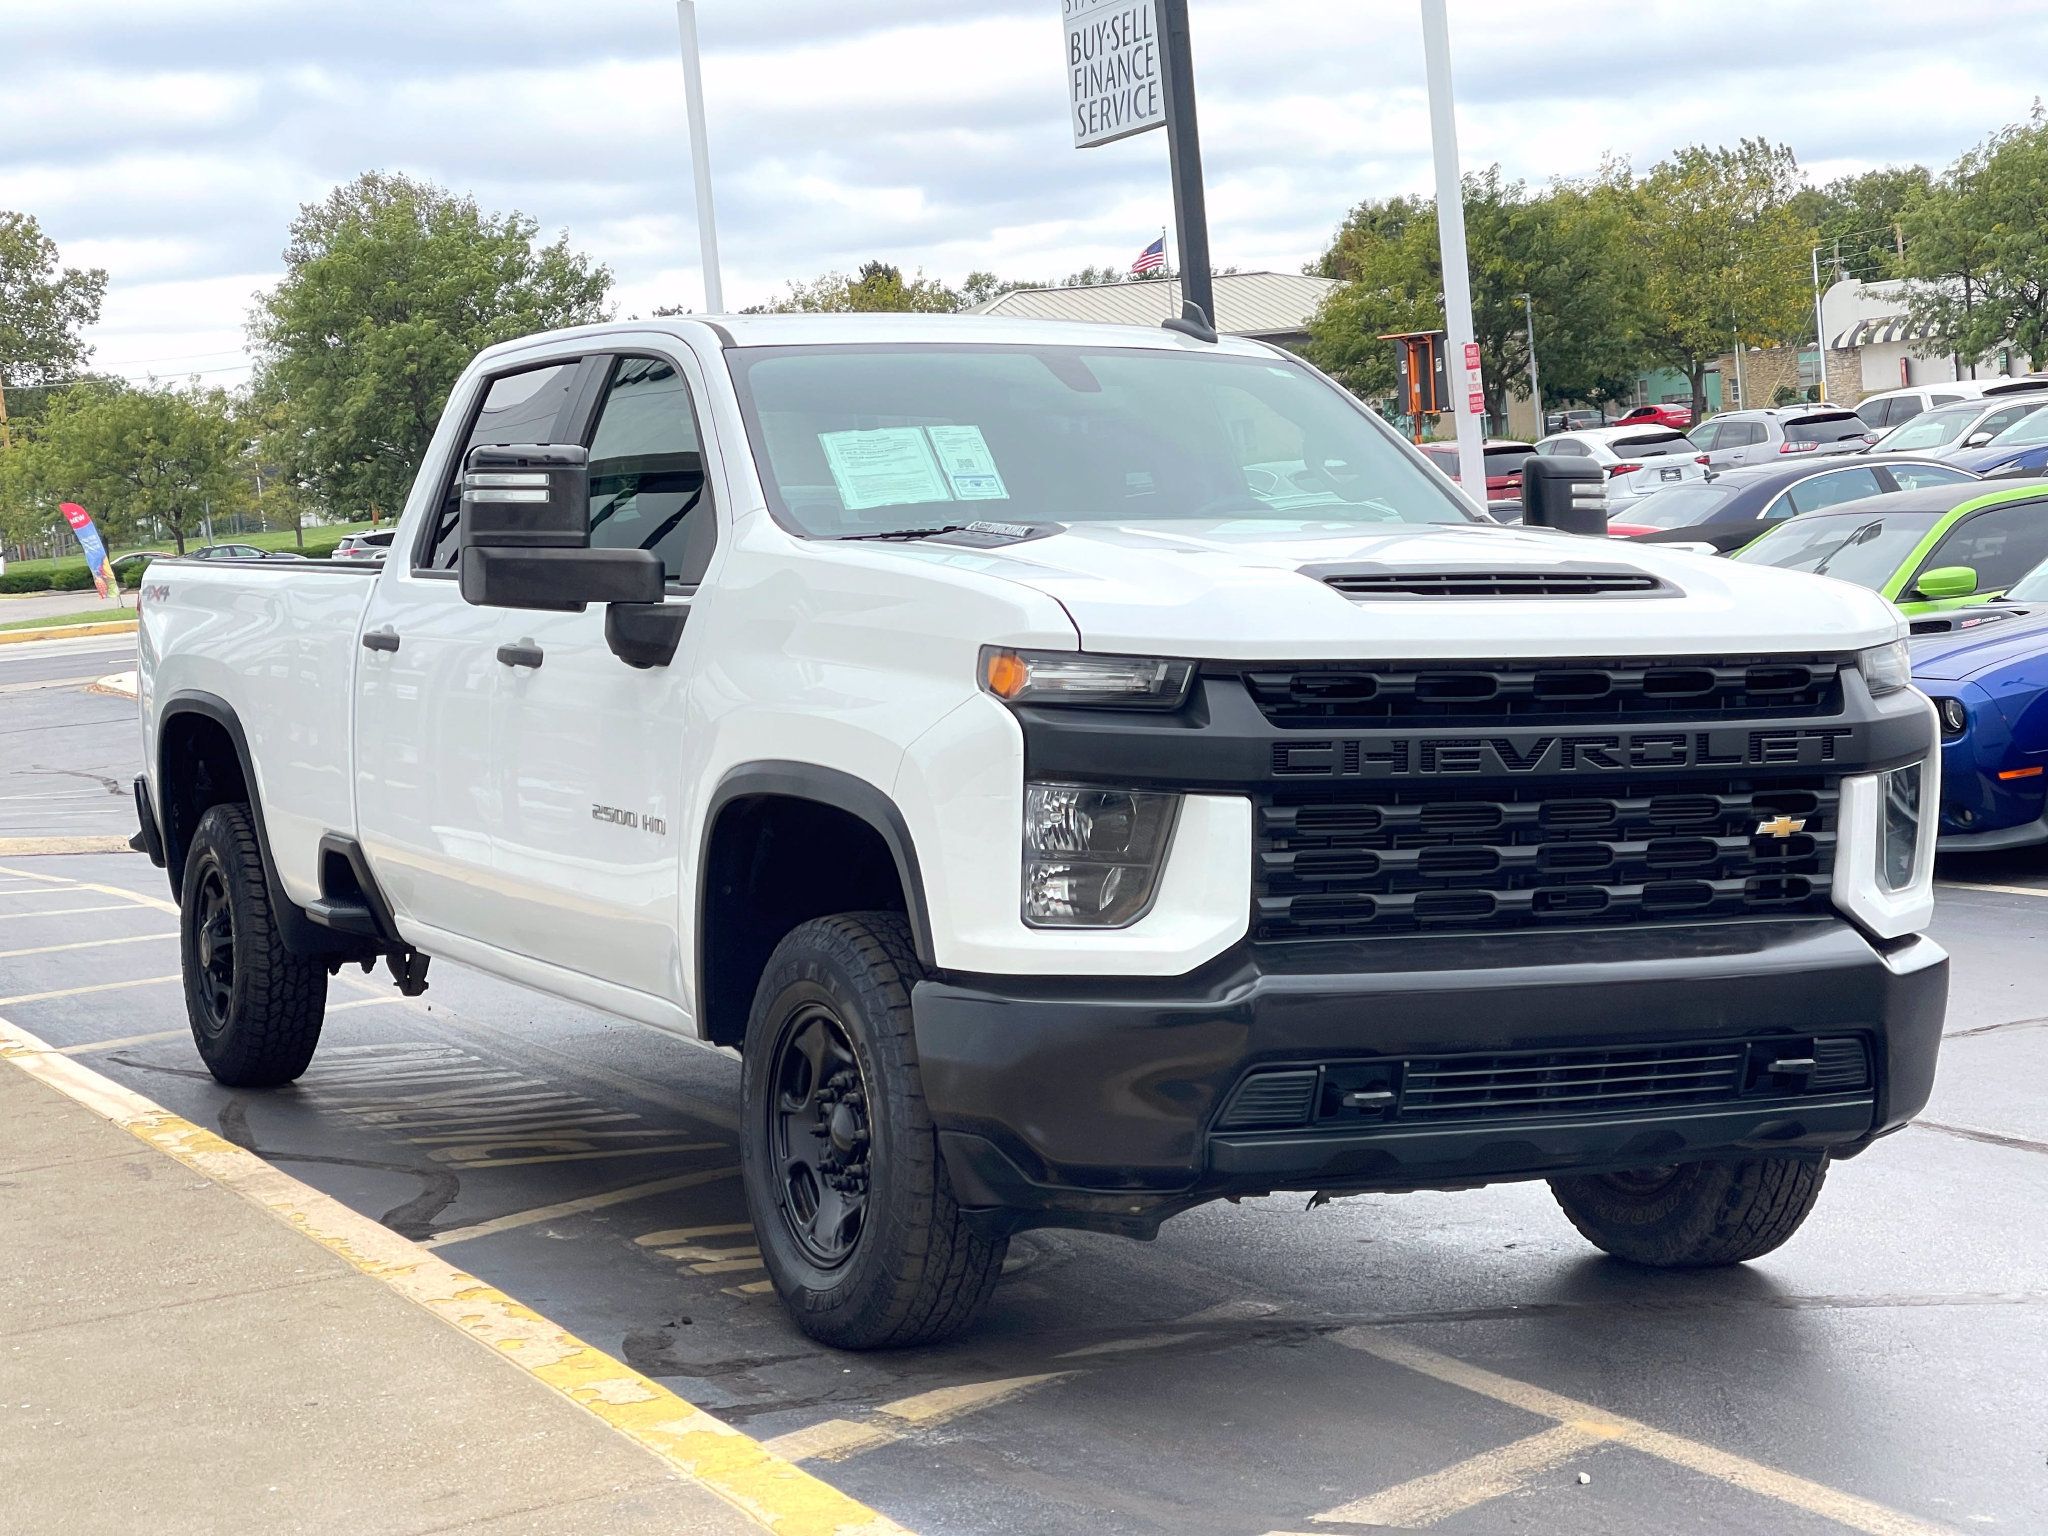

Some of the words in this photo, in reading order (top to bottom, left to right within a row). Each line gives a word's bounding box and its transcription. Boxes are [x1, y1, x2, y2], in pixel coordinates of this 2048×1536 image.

[1074, 41, 1155, 102] FINANCE
[1077, 80, 1158, 137] SERVICE
[1271, 728, 1853, 776] CHEVROLET
[592, 803, 638, 828] 2500
[642, 814, 666, 835] HD
